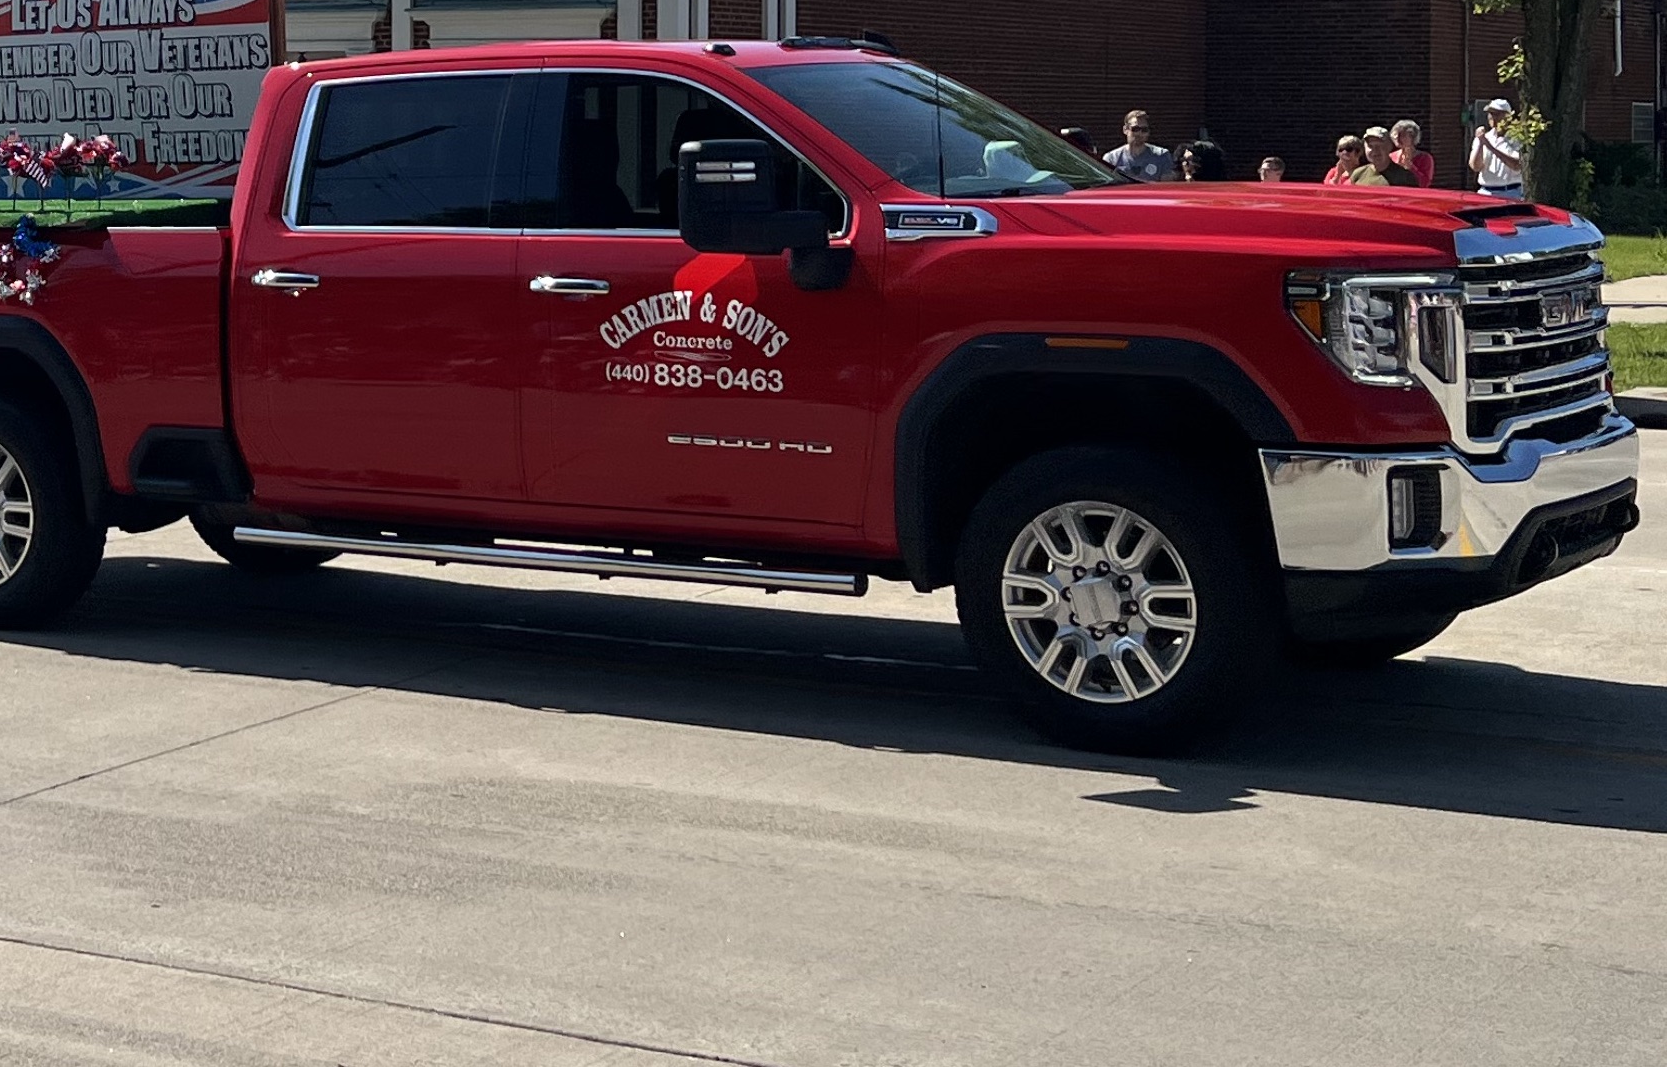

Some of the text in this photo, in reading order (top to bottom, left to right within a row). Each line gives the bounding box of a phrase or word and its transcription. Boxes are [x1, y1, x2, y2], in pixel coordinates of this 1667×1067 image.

[80, 31, 135, 75] OUR
[138, 28, 270, 71] VETERANS
[53, 78, 114, 122] DIED
[116, 76, 170, 120] FOR
[173, 73, 233, 118] OUR
[600, 290, 790, 358] CARMEN & SON'S
[653, 331, 733, 350] Concrete
[606, 362, 784, 393] (440) 838-0463
